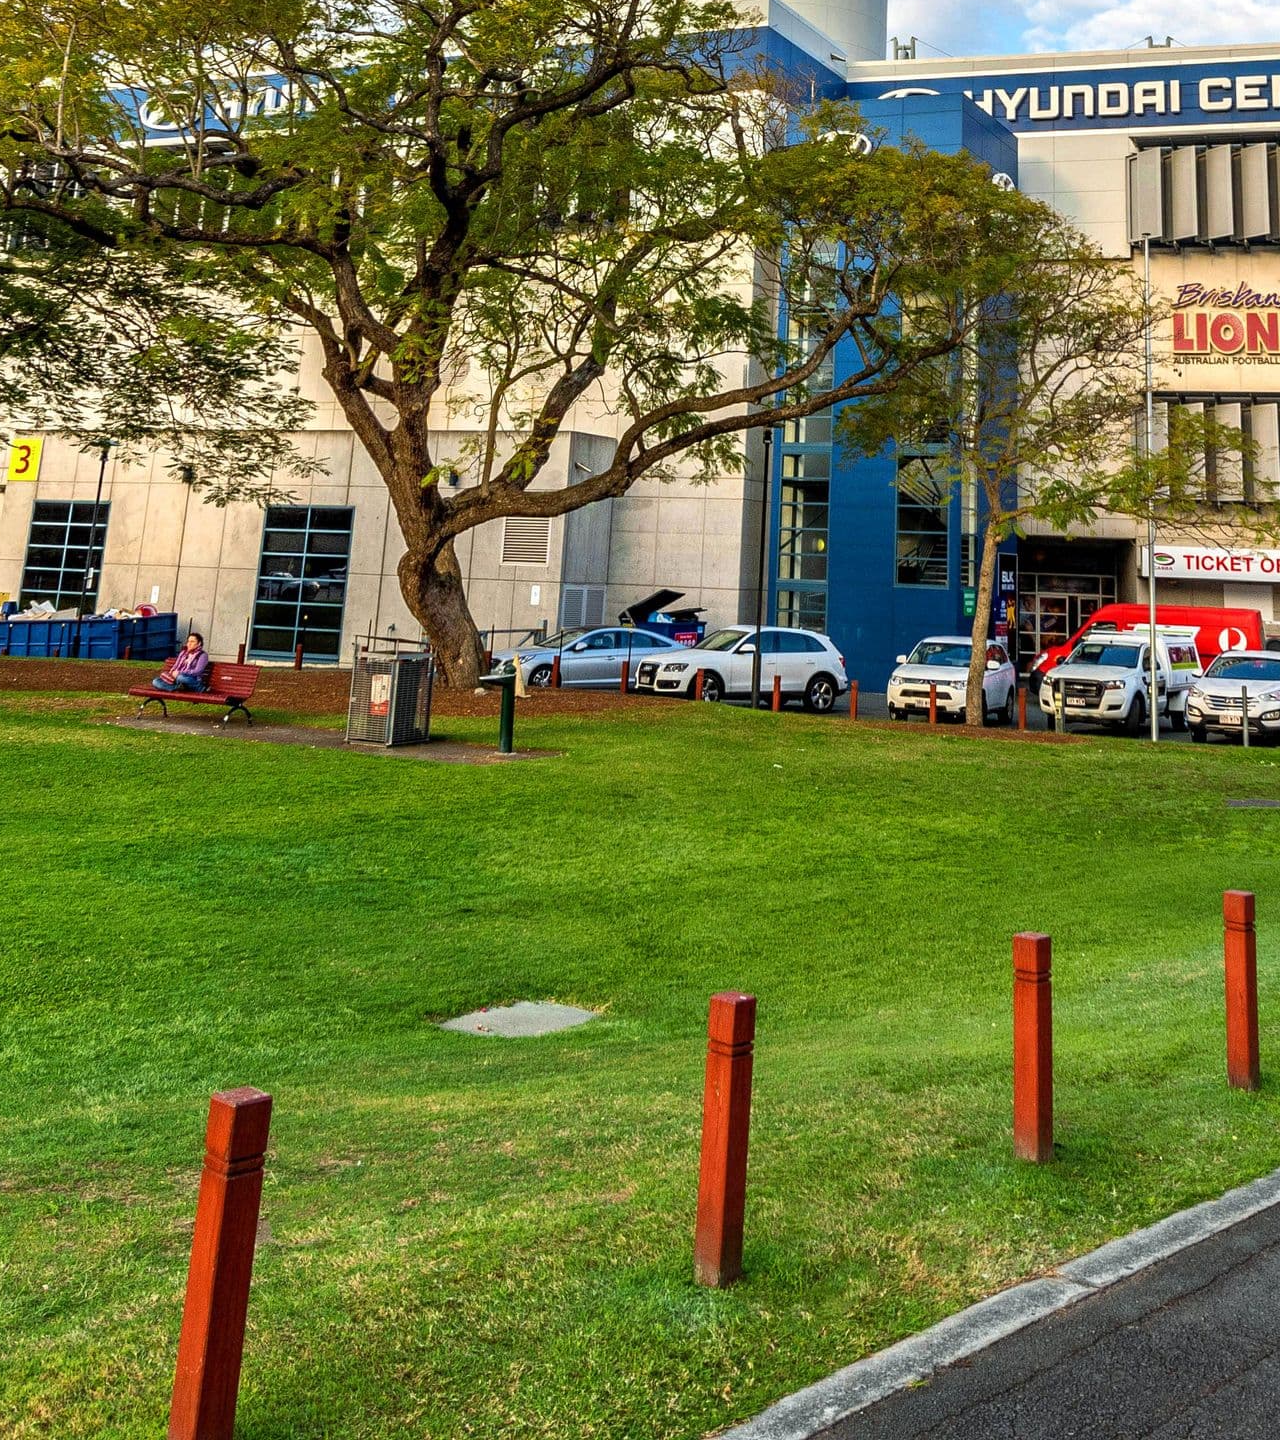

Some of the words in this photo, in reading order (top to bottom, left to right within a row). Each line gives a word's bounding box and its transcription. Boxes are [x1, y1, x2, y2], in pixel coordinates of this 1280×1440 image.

[1173, 356, 1229, 365] AUSTRALIAN
[1232, 356, 1280, 365] FOOTBALL
[14, 444, 32, 474] 3
[1182, 554, 1254, 573] TICKET
